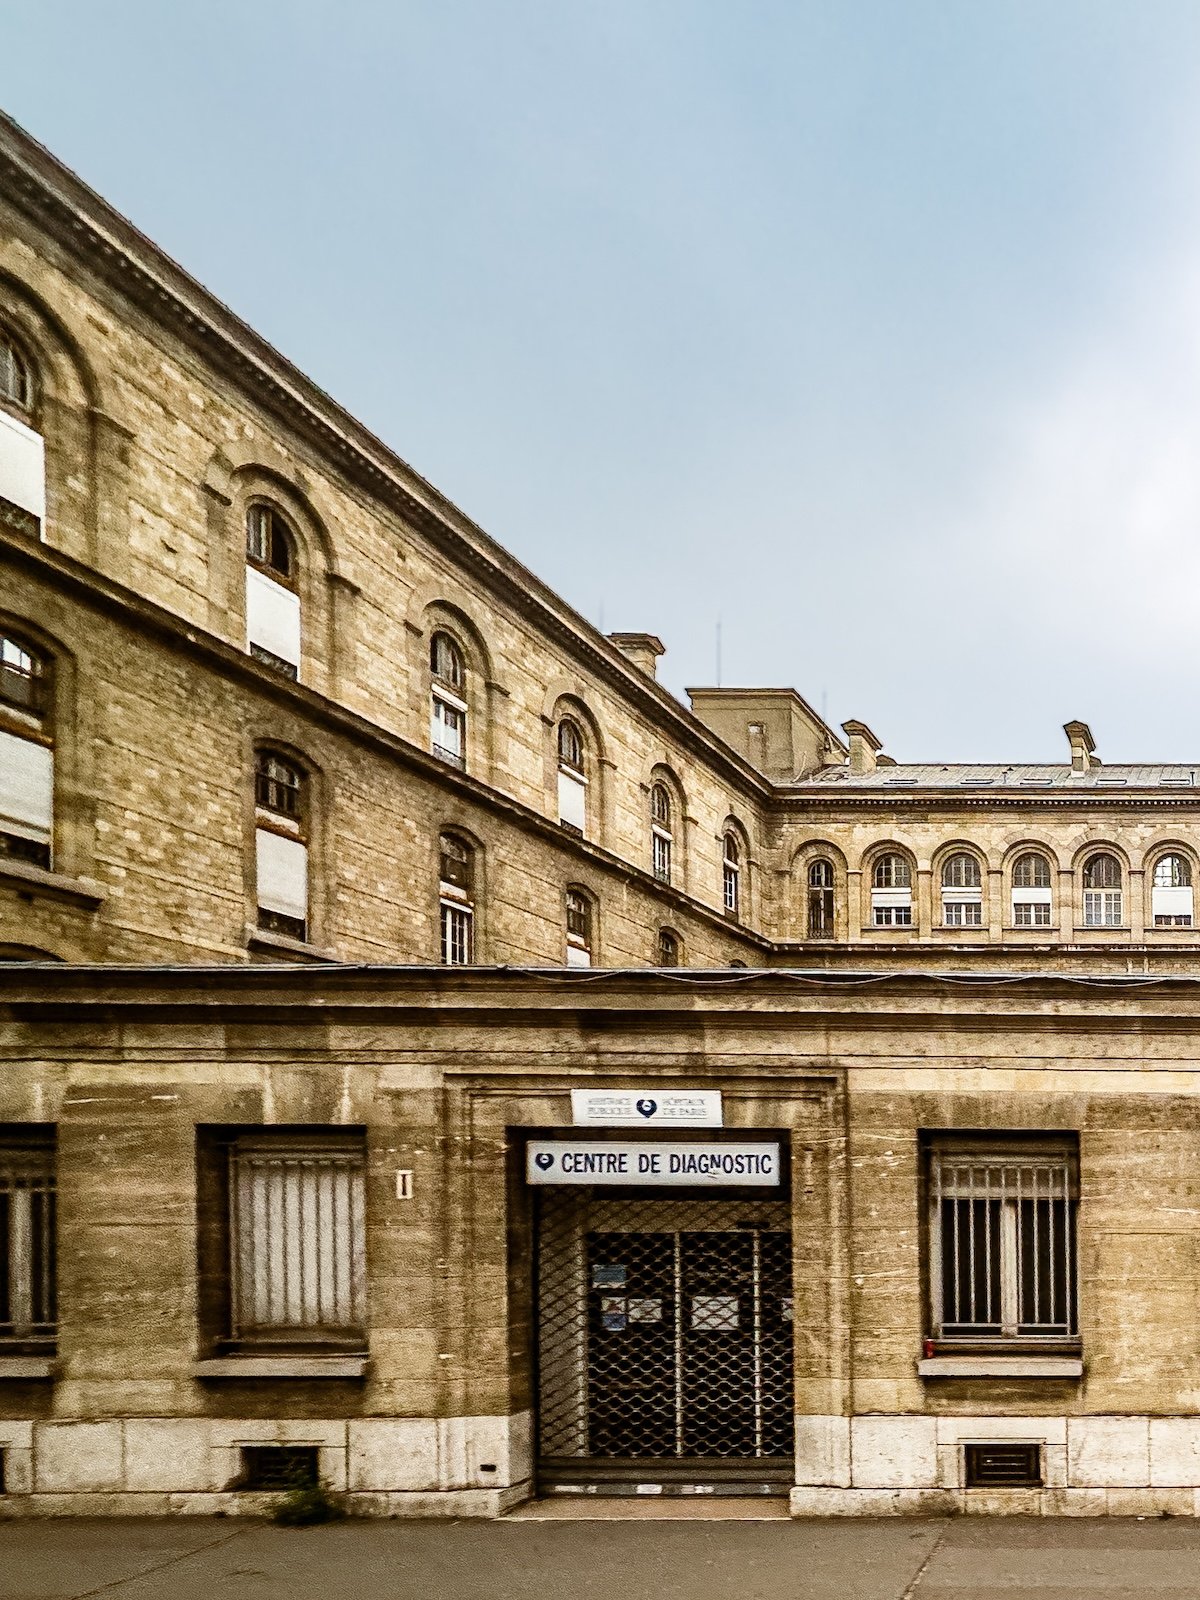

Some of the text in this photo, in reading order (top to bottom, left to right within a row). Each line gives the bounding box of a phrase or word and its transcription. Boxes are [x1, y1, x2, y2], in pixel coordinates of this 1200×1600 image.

[561, 1153, 772, 1174] CENTRE DE DIAGNOSTIC
